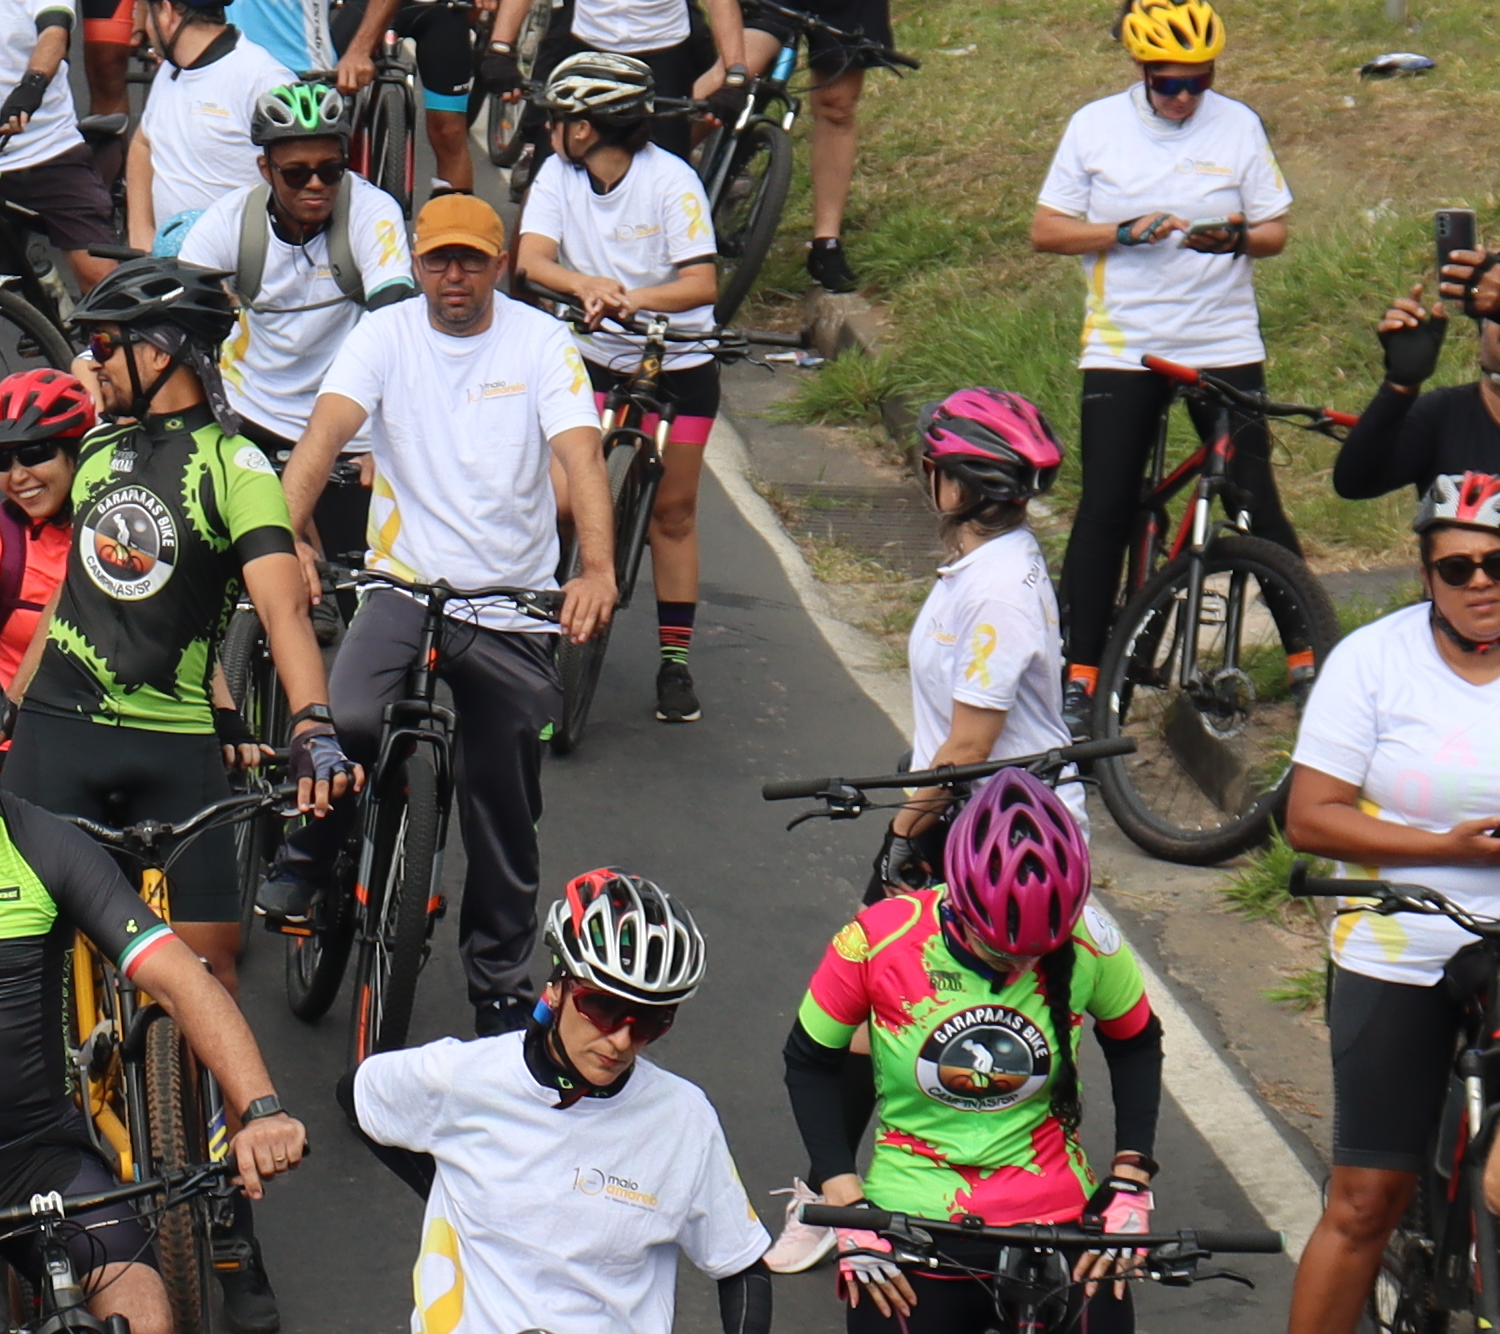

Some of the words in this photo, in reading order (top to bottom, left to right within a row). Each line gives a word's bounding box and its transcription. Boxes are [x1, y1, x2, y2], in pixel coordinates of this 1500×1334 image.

[158, 519, 176, 549] BIKE
[932, 1005, 1021, 1045] GARAPAAAS
[1022, 1018, 1046, 1059] BIKE
[605, 1185, 659, 1208] amarelo
[607, 1173, 641, 1191] maio
